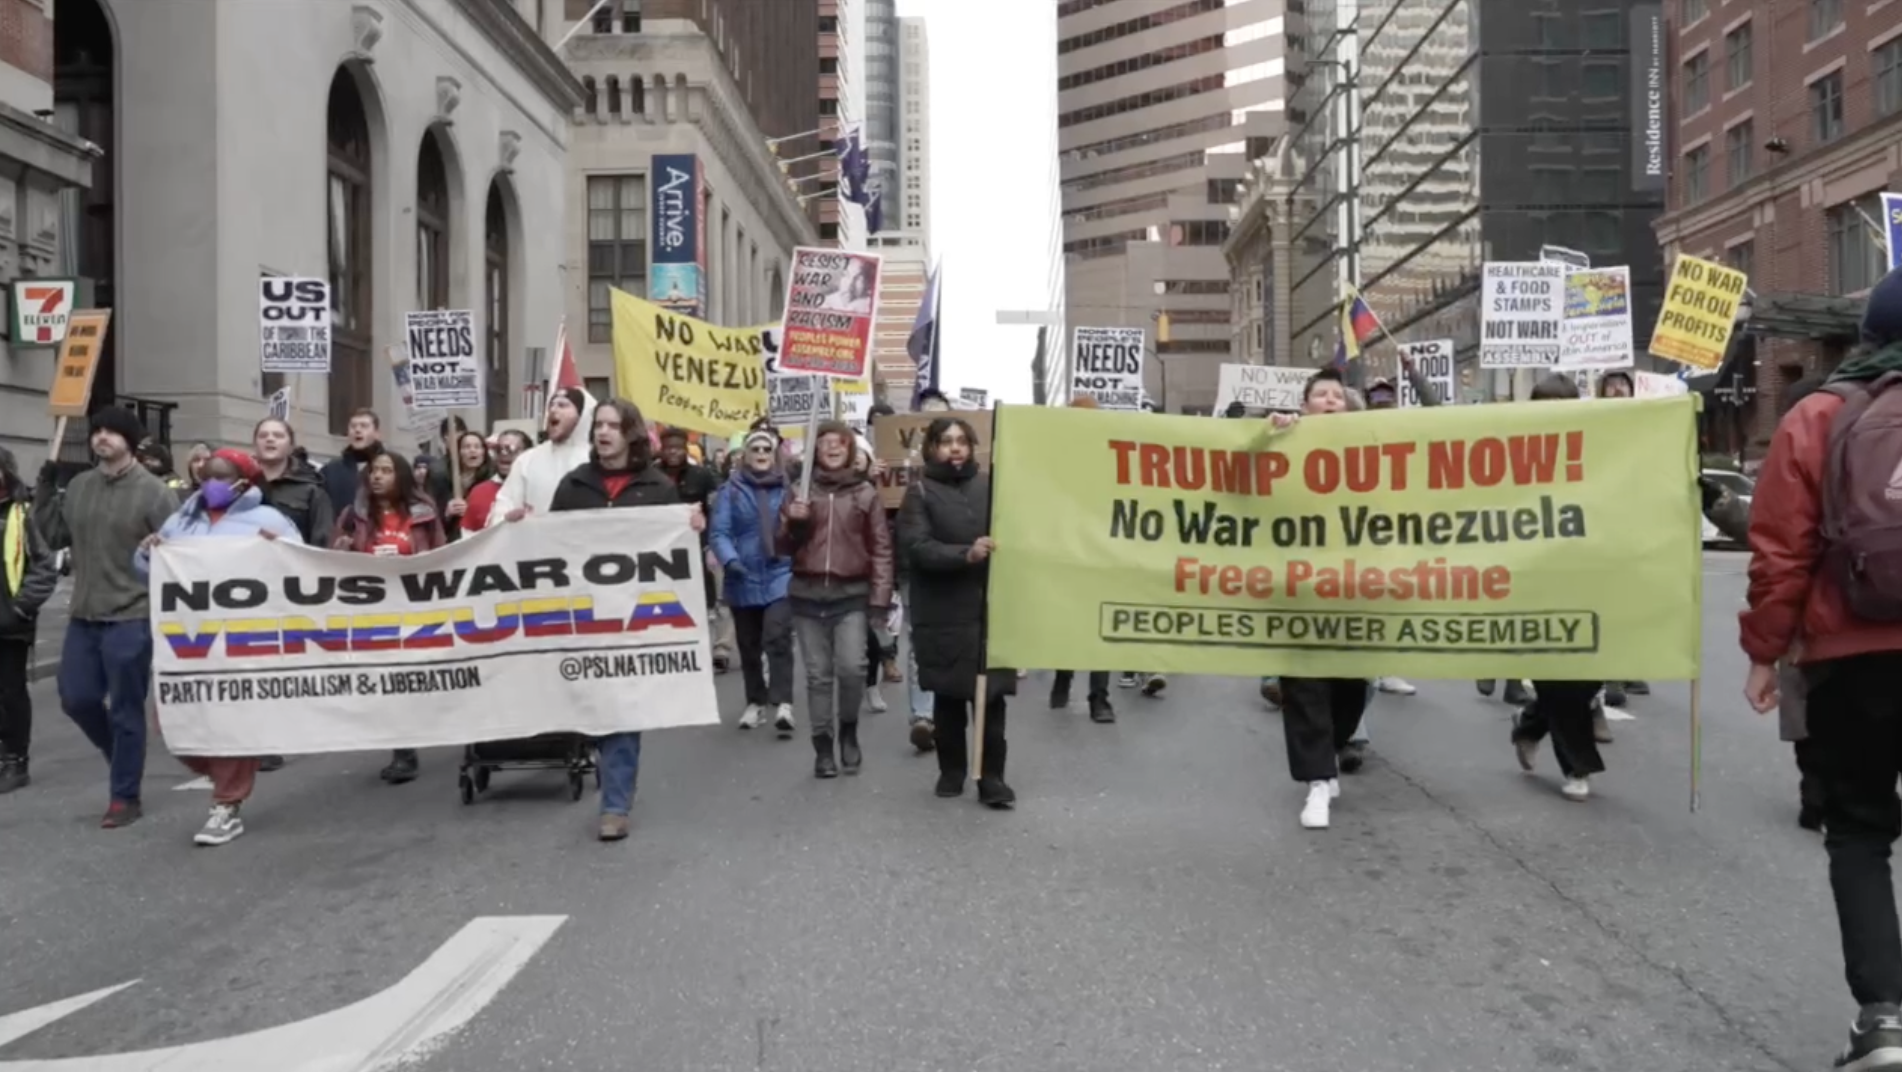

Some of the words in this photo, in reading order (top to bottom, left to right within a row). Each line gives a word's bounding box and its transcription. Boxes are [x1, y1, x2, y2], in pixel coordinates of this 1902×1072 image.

[1648, 68, 1660, 88] INN
[1645, 90, 1661, 175] Residence
[799, 253, 851, 270] RESIST
[1488, 265, 1561, 278] HEALTHCARE
[794, 272, 832, 286] WAR
[1495, 280, 1507, 295] &
[1511, 280, 1550, 295] FOOD
[1678, 260, 1703, 281] NO
[1707, 268, 1743, 294] WAR
[263, 280, 325, 303] US
[793, 291, 826, 308] AND
[1670, 284, 1705, 309] FOR
[1706, 296, 1732, 319] OIL
[25, 287, 64, 342] 7
[262, 305, 326, 321] OUT
[1493, 297, 1551, 312] STAMPS
[788, 311, 852, 329] RACISM
[1485, 320, 1515, 340] NOT
[1517, 319, 1559, 340] WAR!
[1662, 310, 1728, 343] PROFITS
[309, 326, 328, 341] THE
[409, 326, 474, 360] NEEDS
[655, 314, 694, 346] NO
[708, 329, 762, 356] WAR
[263, 342, 327, 359] CARIBBEAN
[1076, 343, 1140, 374] NEEDS
[1410, 343, 1441, 356] NO
[411, 362, 460, 375] NOT
[1241, 367, 1268, 384] NO
[1073, 377, 1124, 389] NOT
[1108, 439, 1290, 496] TRUMP
[1303, 442, 1416, 494] OUT
[1428, 430, 1583, 489] NOW!
[1110, 499, 1164, 541] No
[1173, 499, 1260, 547] War
[1271, 514, 1327, 547] on
[1339, 495, 1586, 547] Venezuela
[161, 578, 269, 612] NO
[283, 575, 386, 605] US
[400, 558, 570, 602] WAR
[582, 548, 692, 585] ON
[1174, 557, 1274, 599] Free
[1286, 557, 1511, 601] Palestine
[158, 590, 697, 659] VENEZUELA
[1112, 609, 1255, 638] PEOPLES
[1266, 615, 1386, 641] POWER
[1396, 617, 1582, 644] ASSEMBLY
[559, 650, 702, 681] @PSLNATIONAL
[159, 679, 214, 704] PARTY
[218, 677, 253, 702] FOR
[257, 674, 351, 699] SOCIALISM
[356, 673, 377, 696] &
[381, 666, 482, 695] LIBERATION
